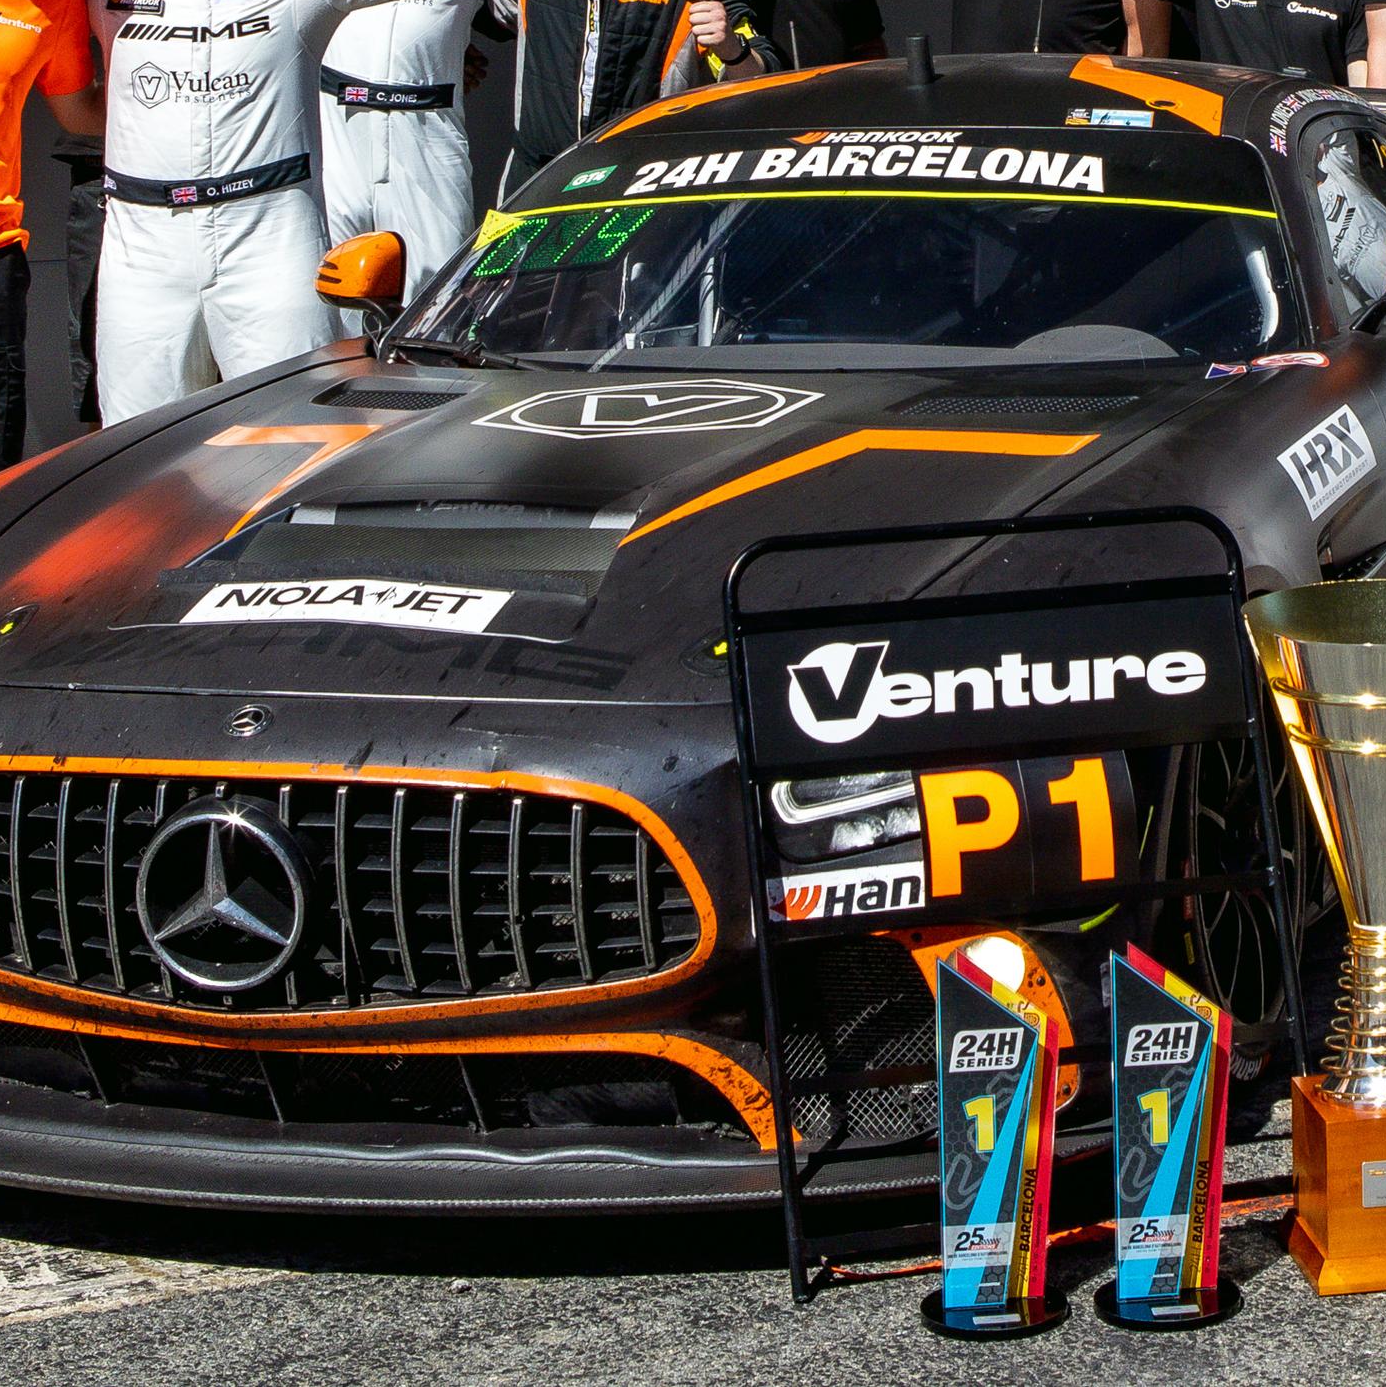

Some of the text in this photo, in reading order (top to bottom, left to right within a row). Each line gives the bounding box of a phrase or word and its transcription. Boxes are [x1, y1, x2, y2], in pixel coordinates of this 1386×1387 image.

[1286, 0, 1338, 21] Venture
[162, 15, 271, 43] AMG
[169, 69, 251, 94] Vulcan
[174, 86, 252, 104] Fasteners
[376, 92, 417, 103] C. JONES
[570, 169, 609, 187] GT4
[623, 144, 1106, 197] 24H BARCELONA
[206, 178, 255, 197] O. HIZZEY
[1288, 411, 1366, 501] HRX
[214, 584, 484, 615] NIOLA JET
[786, 639, 1208, 744] Venture
[957, 1031, 1019, 1059] 24H
[1131, 1026, 1193, 1052] 24H
[955, 1056, 1015, 1069] SERIES
[1129, 1048, 1190, 1063] SERIES
[962, 1094, 997, 1153] 1
[1136, 1088, 1171, 1147] 1
[1018, 1167, 1038, 1253] BARCELONA
[1191, 1158, 1210, 1244] BARCELONA
[954, 1226, 986, 1252] 25
[1128, 1218, 1160, 1244] 25
